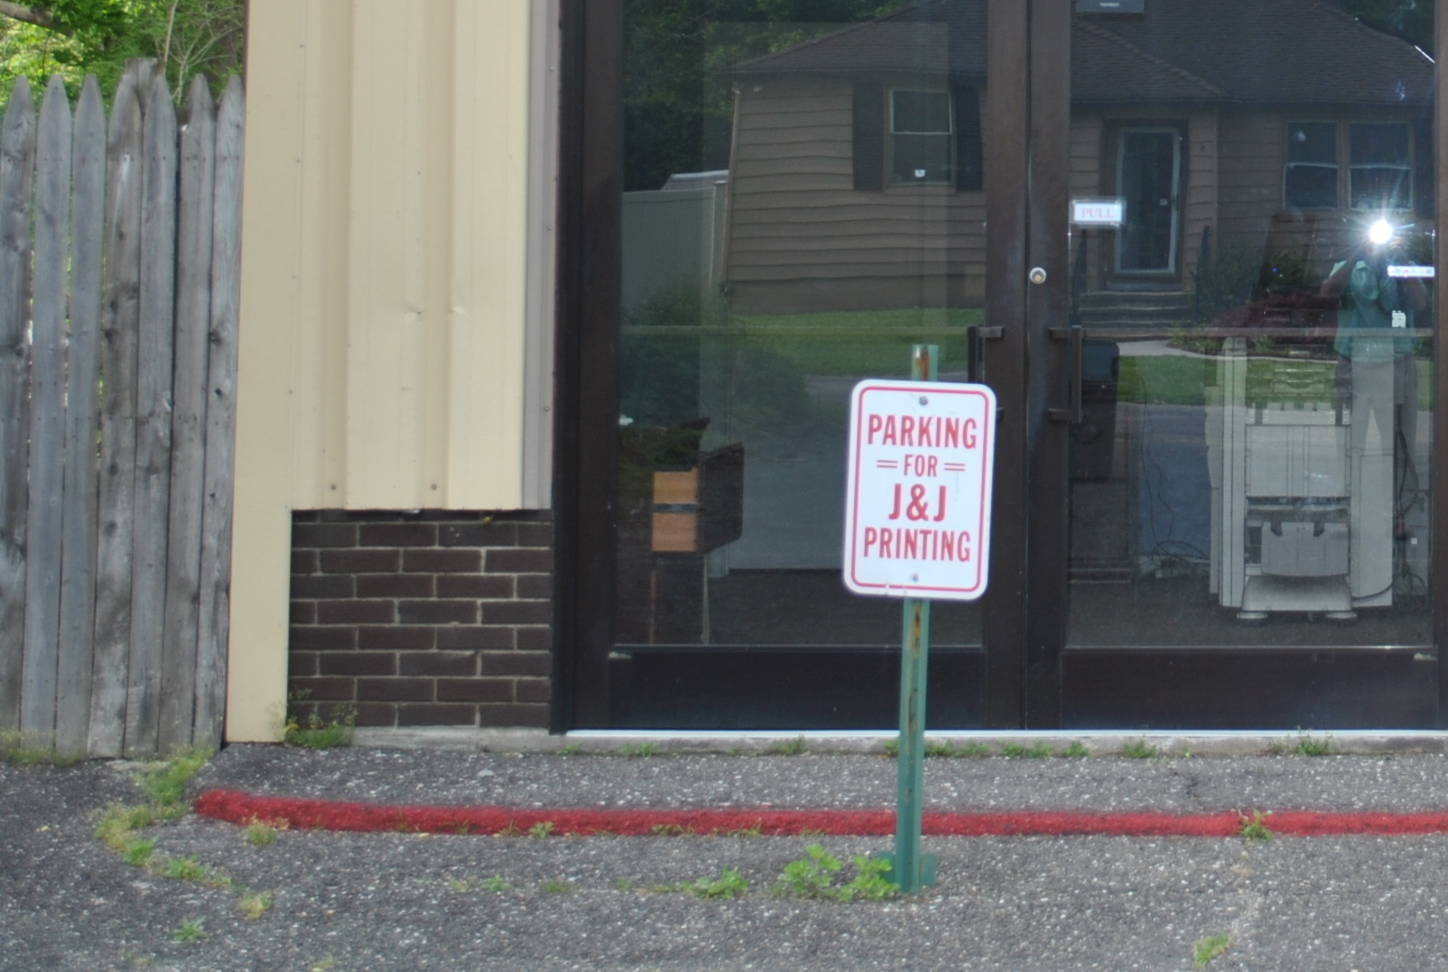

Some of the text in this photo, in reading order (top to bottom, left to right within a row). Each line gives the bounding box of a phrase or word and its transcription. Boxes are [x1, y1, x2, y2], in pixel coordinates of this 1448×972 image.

[1082, 207, 1114, 218] PULL
[867, 414, 977, 449] PARKING
[903, 454, 938, 477] FOR
[888, 483, 947, 522] J&J
[863, 527, 971, 562] PRINTING
